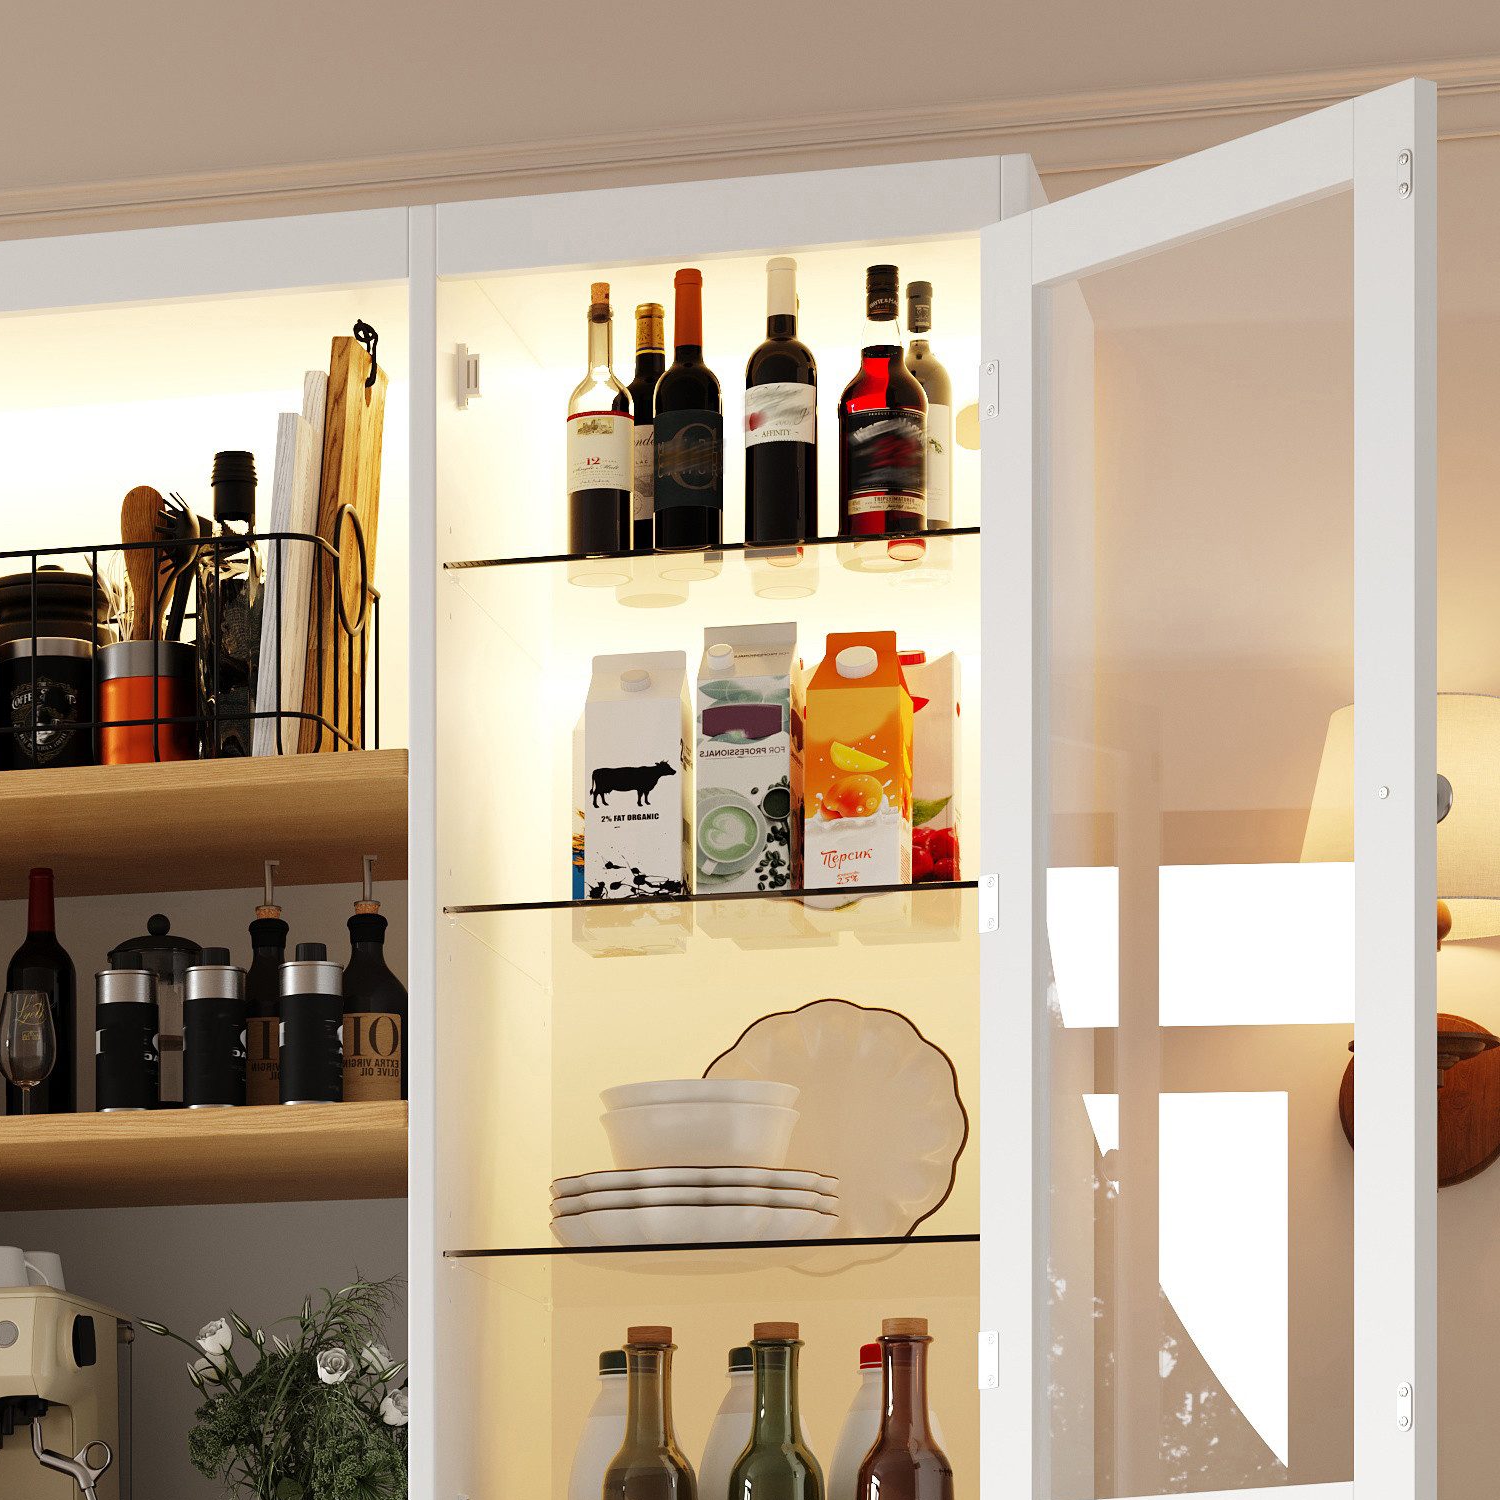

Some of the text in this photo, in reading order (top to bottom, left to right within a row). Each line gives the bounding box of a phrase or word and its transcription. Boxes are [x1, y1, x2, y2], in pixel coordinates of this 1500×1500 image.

[761, 429, 791, 438] AFFINITY
[586, 456, 600, 465] 12
[11, 692, 37, 710] COFFE
[601, 813, 660, 823] 2% FAT ORGANIC
[820, 848, 874, 869] Персик
